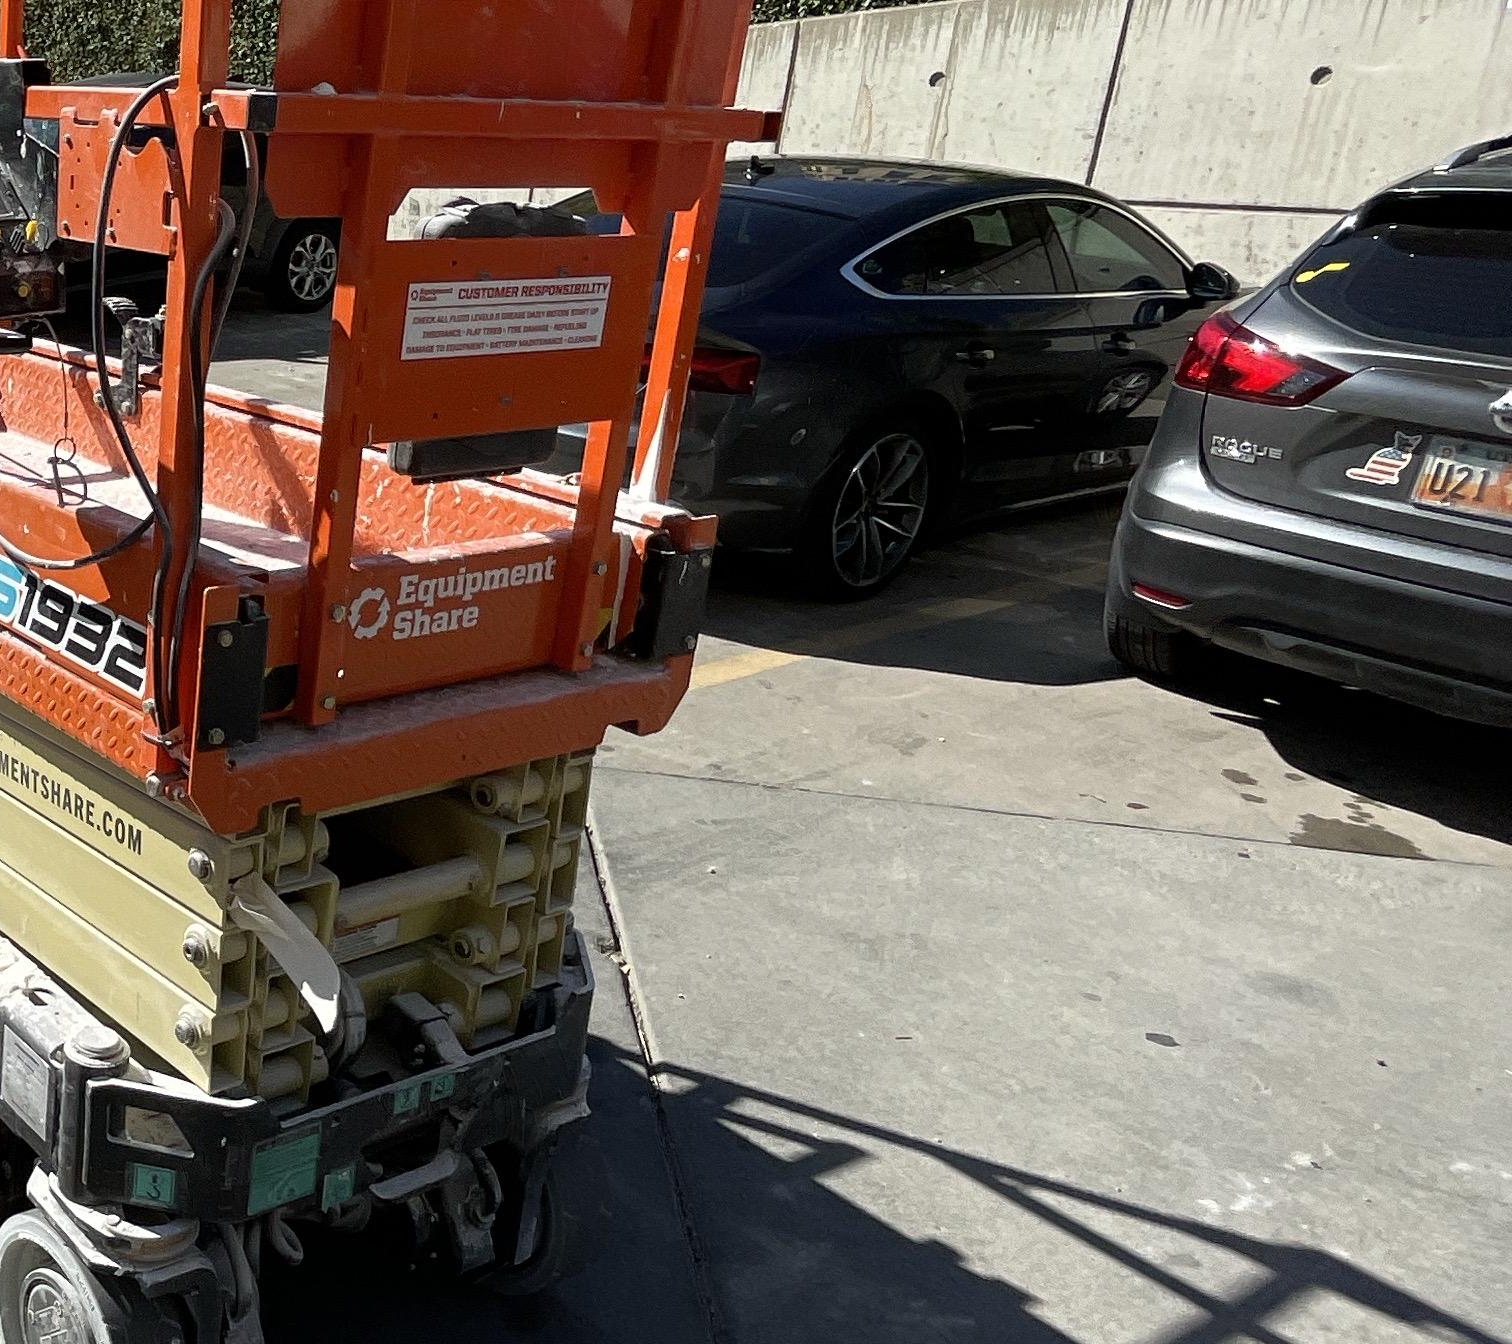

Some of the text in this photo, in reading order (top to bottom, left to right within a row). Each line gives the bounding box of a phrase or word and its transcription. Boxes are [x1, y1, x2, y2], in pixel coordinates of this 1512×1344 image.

[457, 282, 609, 300] CUSTOMER RESPONSIBILITY
[396, 555, 557, 607] Equipment
[392, 605, 480, 641] Share
